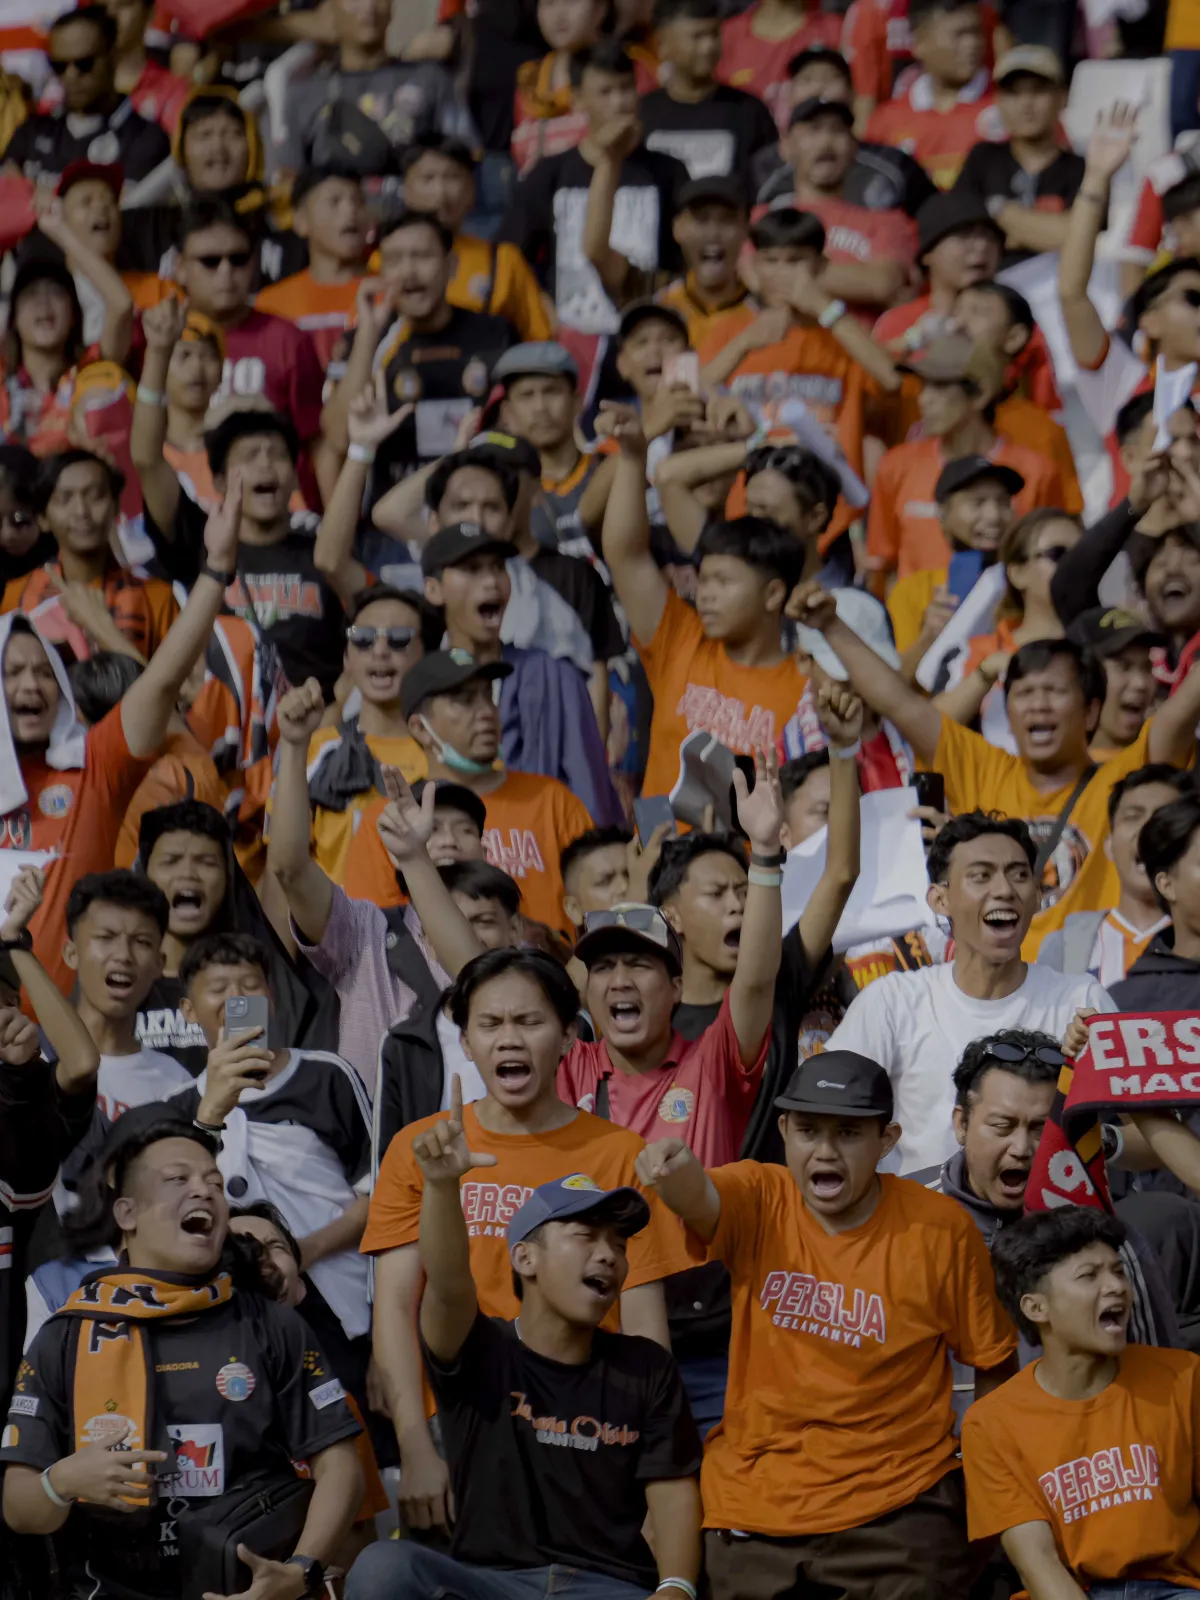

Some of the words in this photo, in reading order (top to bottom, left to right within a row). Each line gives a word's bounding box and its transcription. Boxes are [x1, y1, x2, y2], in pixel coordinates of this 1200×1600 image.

[460, 1182, 535, 1224] ERS
[760, 1270, 886, 1344] PERSIJA
[772, 1314, 862, 1348] SELAMANYA
[1037, 1443, 1160, 1513] PERSIJA
[1063, 1487, 1154, 1524] SELAMANYA
